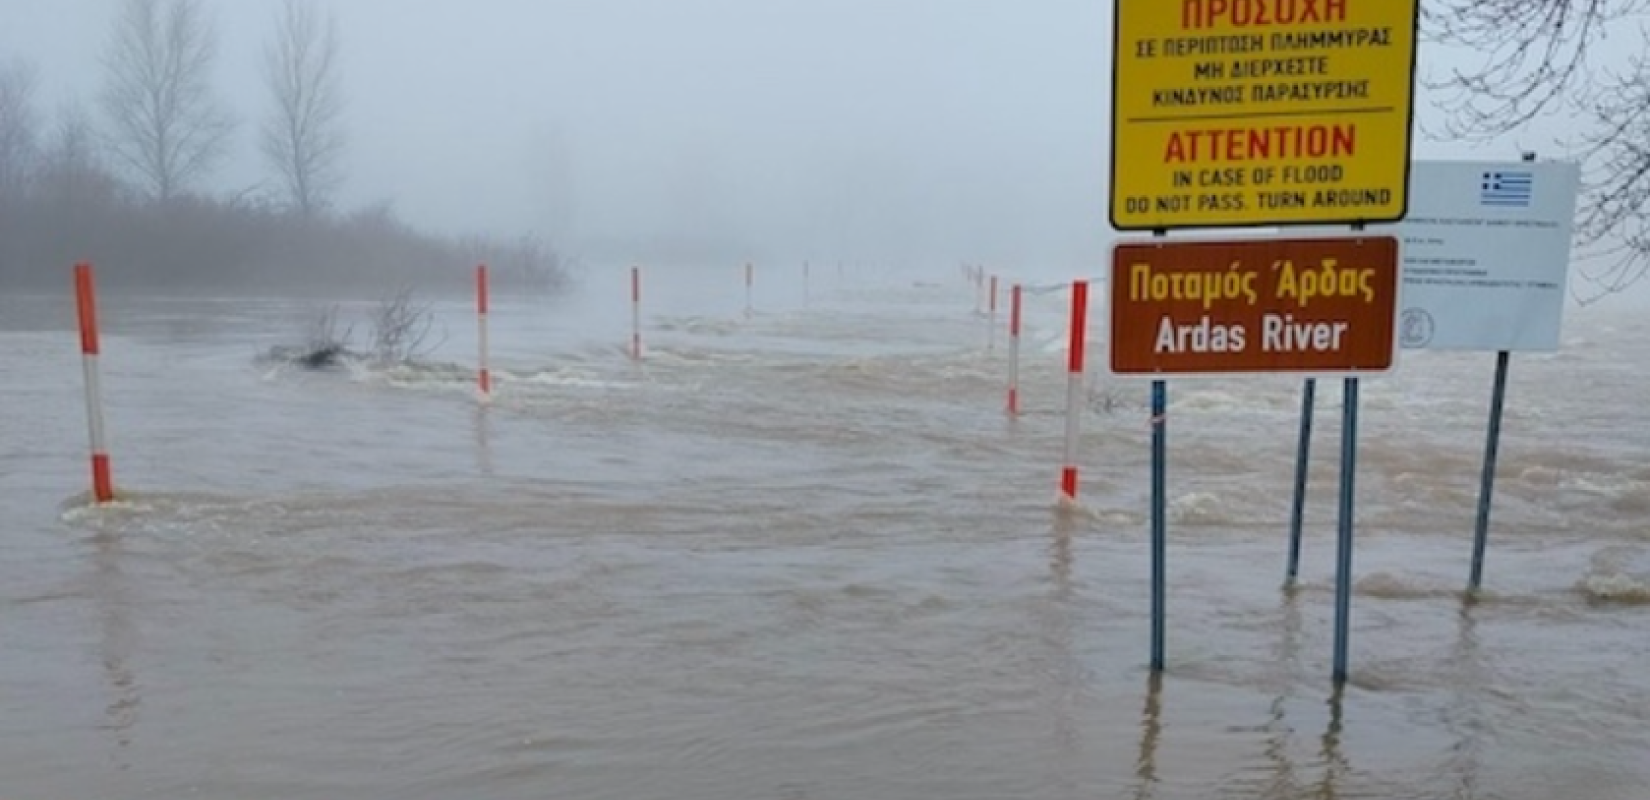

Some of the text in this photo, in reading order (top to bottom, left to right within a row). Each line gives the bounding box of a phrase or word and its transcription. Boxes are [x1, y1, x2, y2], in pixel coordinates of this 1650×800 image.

[1181, 0, 1347, 29] ΠΡΟΣΟΧΗ
[1135, 27, 1393, 57] ΣΕ ΠΕΡΙΠΤΩΣΗ ΠΛΗΜΜΥΡΑΣ
[1193, 55, 1328, 79] ΜΗ ΔΙΕΡΧΕΣΤΕ
[1152, 79, 1370, 107] ΚΙΝΔΥΝΟΣ ΠΑΡΑΣΥΡΣΗΣ
[1163, 124, 1357, 163] ATTENTION
[1172, 164, 1344, 187] IN CASE OF FLOOD
[1125, 187, 1392, 214] DO NOT PASS. TURN AROUND
[1130, 258, 1377, 309] Ποταμός Άρδας
[1154, 312, 1348, 353] Ardas River
